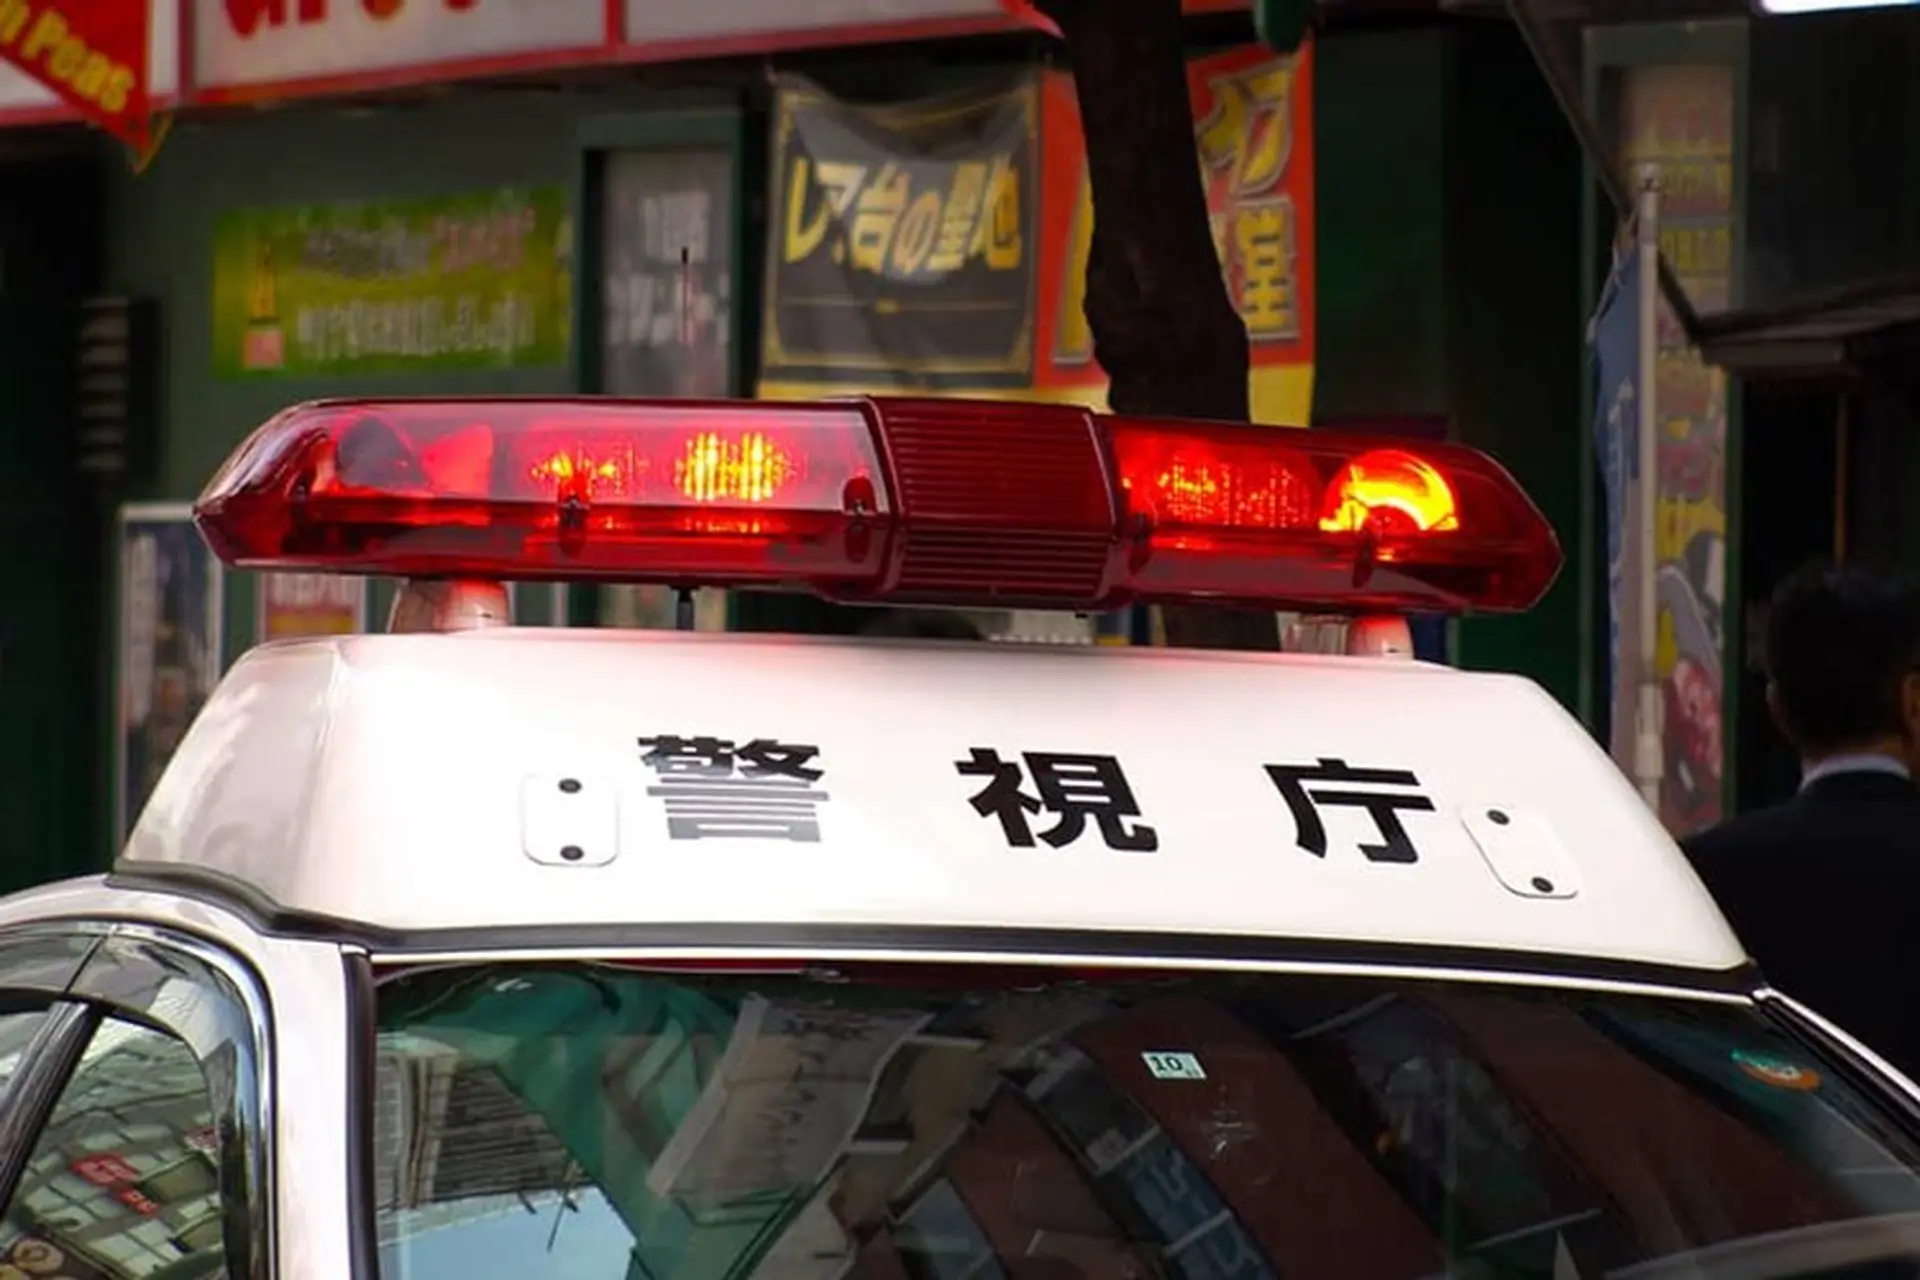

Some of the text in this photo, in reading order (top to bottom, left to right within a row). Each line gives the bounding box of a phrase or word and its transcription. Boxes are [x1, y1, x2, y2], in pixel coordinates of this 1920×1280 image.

[21, 8, 136, 114] Peas
[637, 734, 1436, 864] 警視庁
[1149, 1055, 1184, 1072] 10
